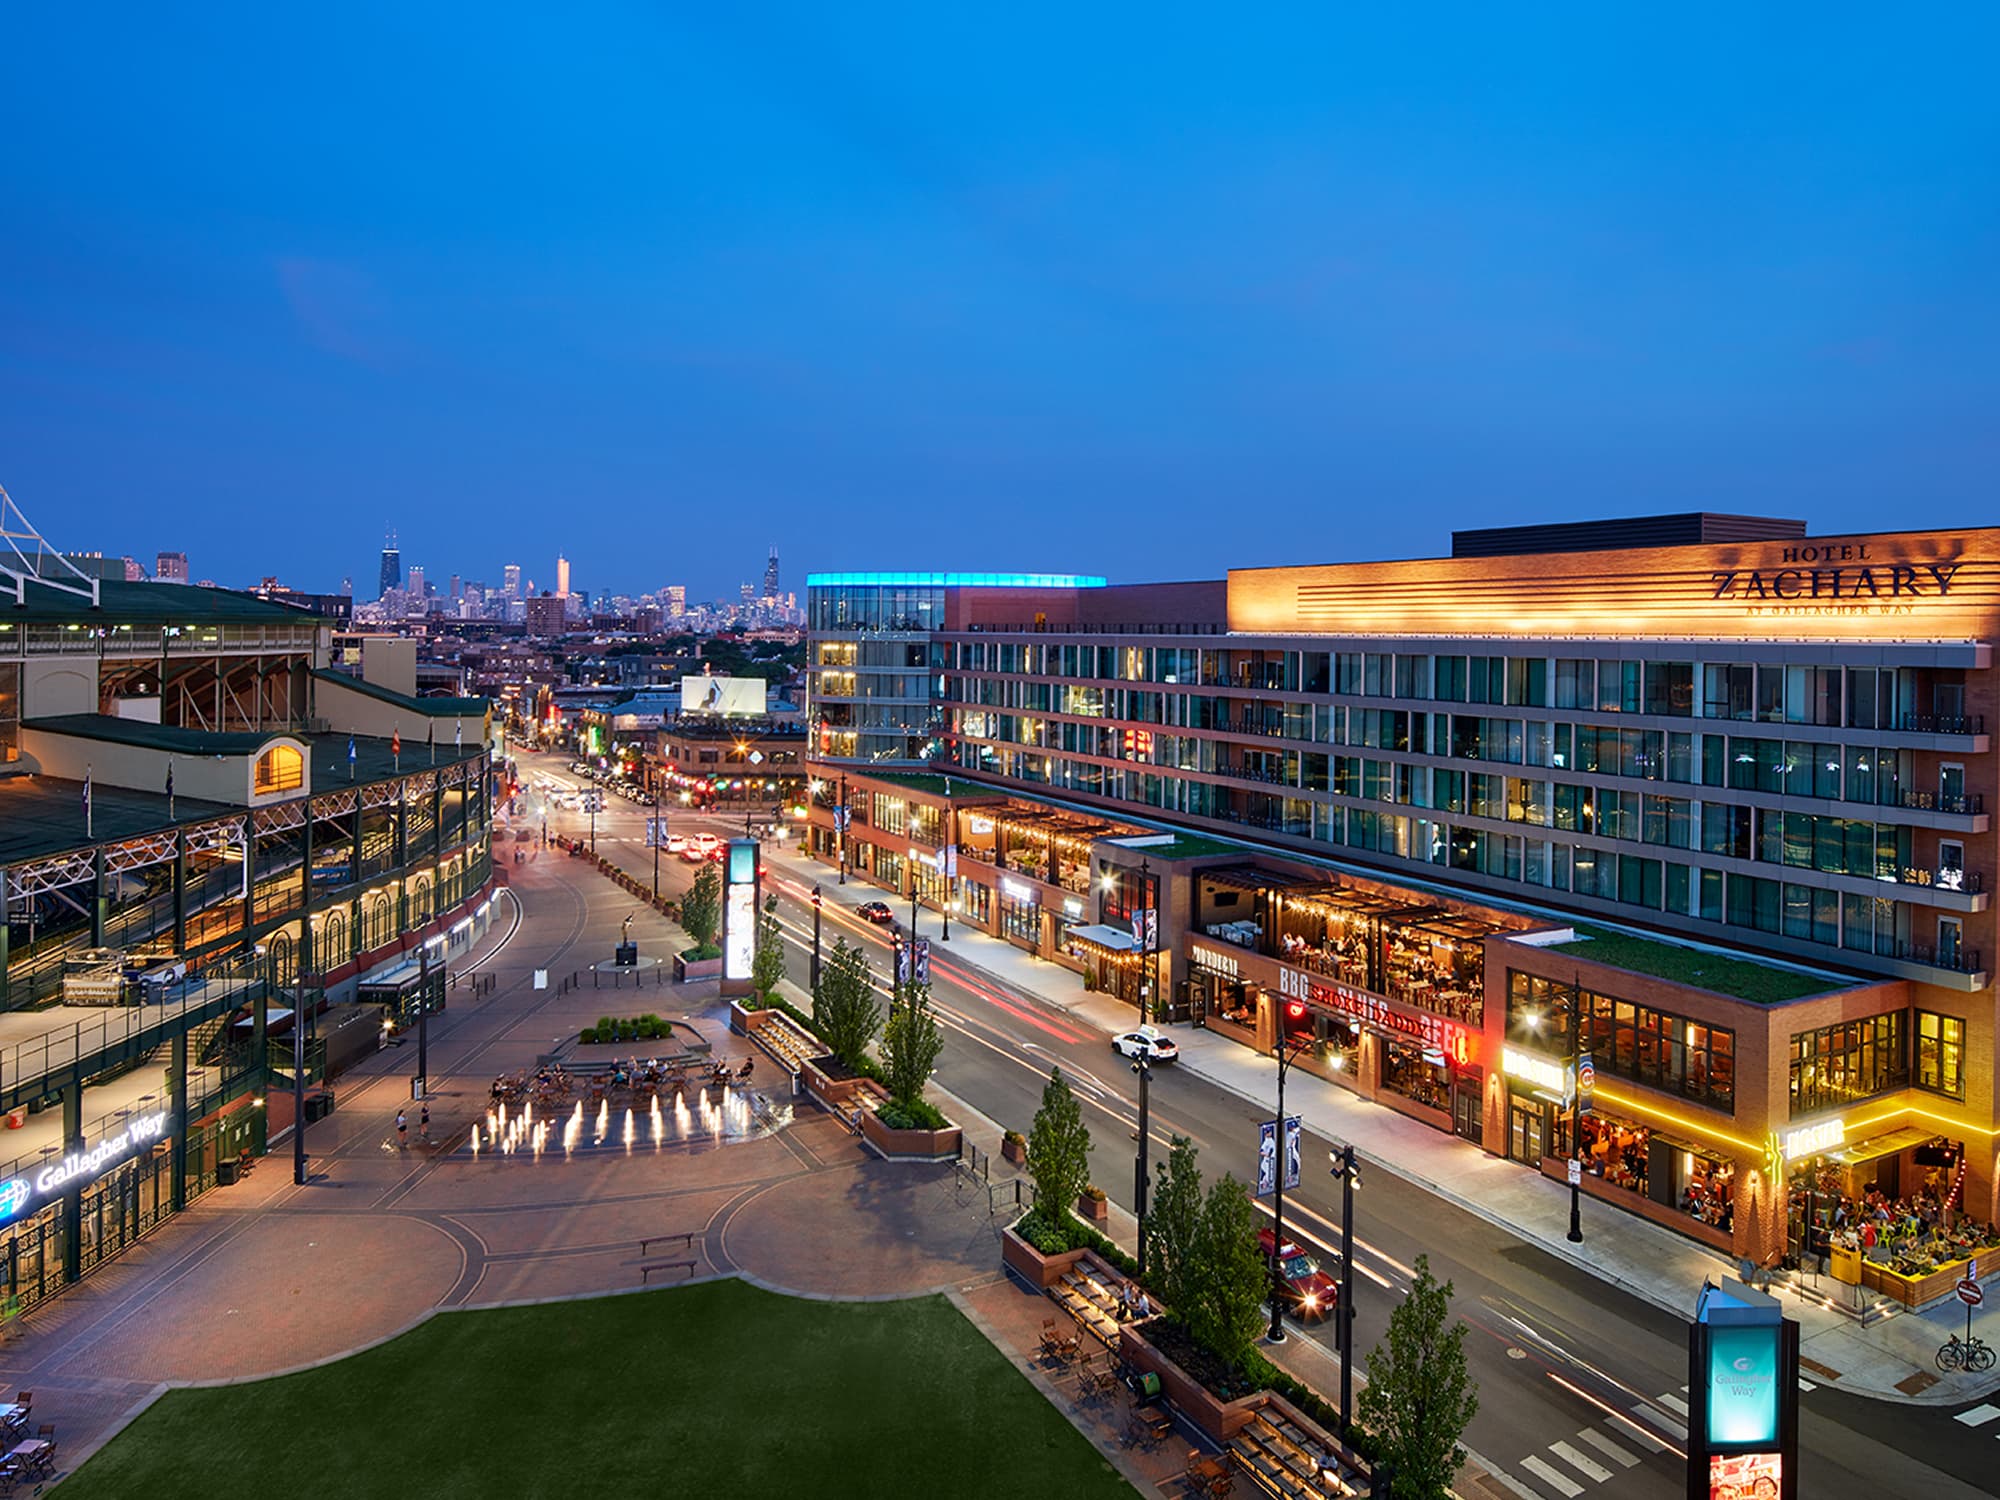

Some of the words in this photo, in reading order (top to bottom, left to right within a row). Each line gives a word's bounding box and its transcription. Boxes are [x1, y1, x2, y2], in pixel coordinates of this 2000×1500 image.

[1783, 545, 1871, 562] HOTEL
[1711, 564, 1962, 600] ZACHARY
[1746, 606, 1763, 615] AT
[1772, 605, 1870, 615] GALLAGHER
[1880, 604, 1915, 615] WAY
[1280, 967, 1309, 1001] BBQ
[37, 1131, 129, 1192] Gallagher
[129, 1112, 166, 1143] Way
[1715, 1374, 1772, 1386] Gallagher
[1731, 1386, 1756, 1397] Way
